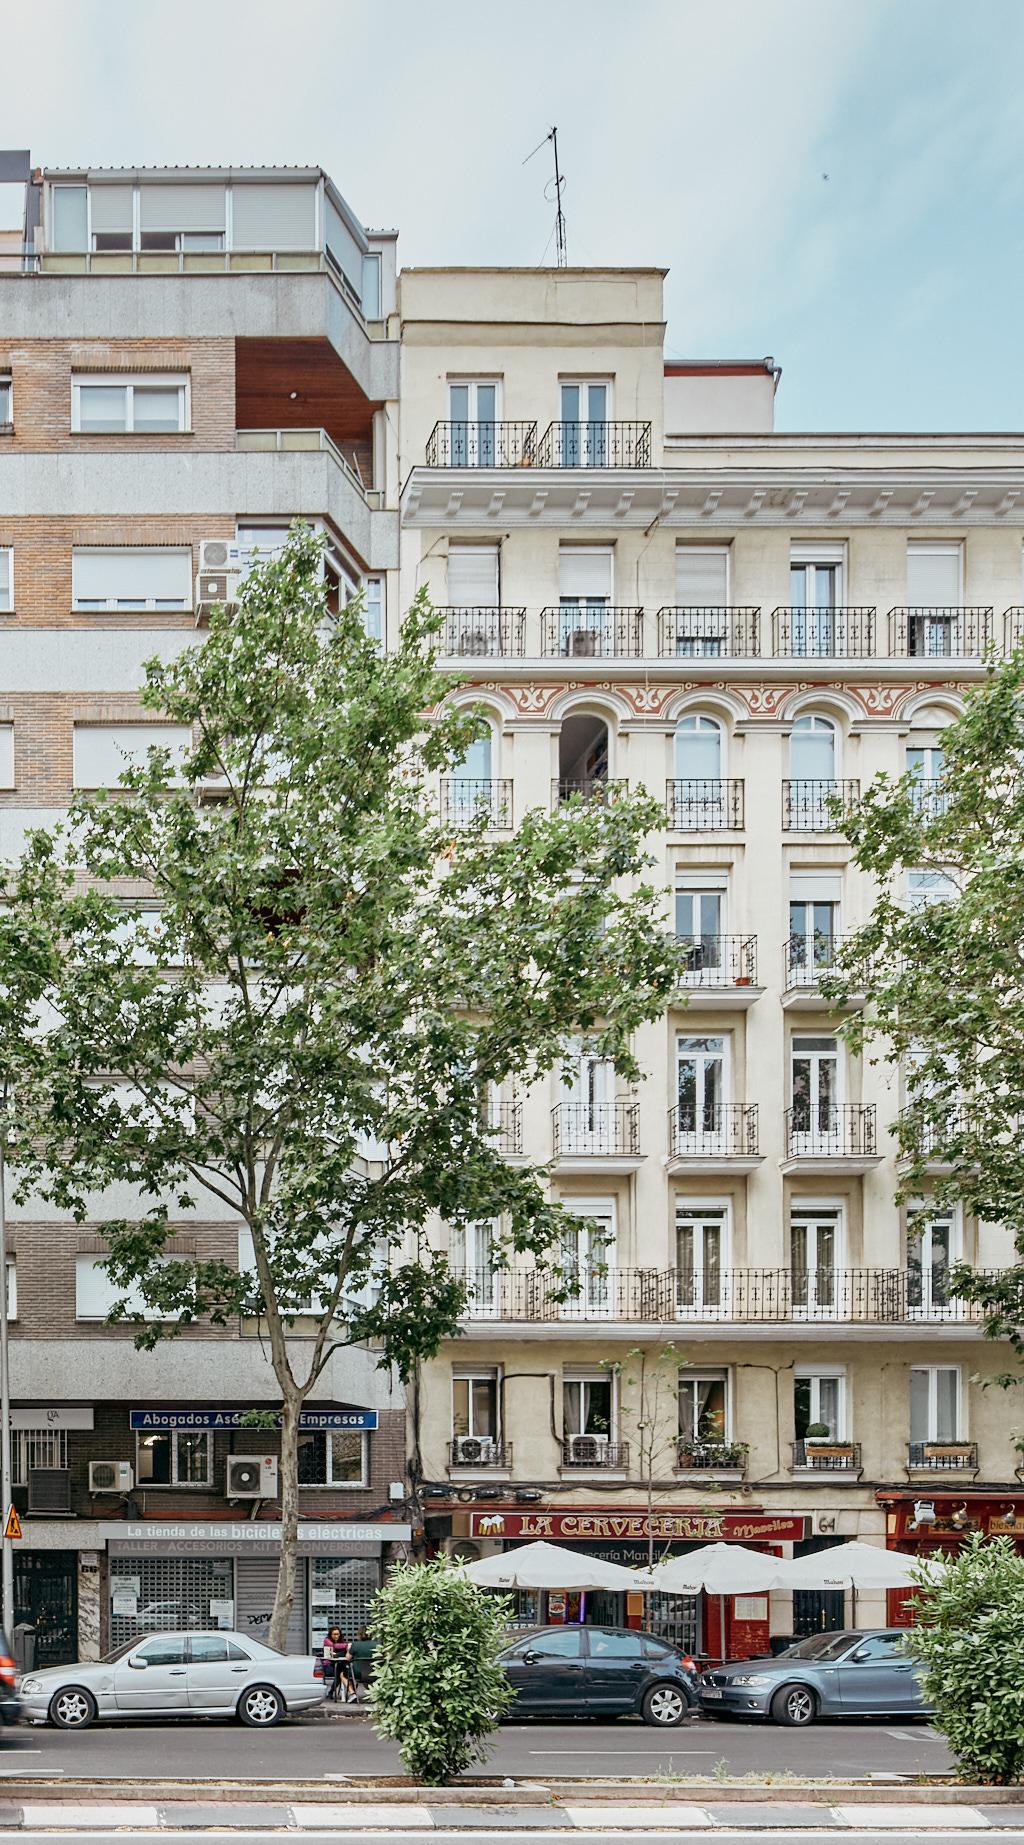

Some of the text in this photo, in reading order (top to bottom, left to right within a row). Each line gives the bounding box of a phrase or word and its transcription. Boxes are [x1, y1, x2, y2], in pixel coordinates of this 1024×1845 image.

[142, 1413, 210, 1427] Abogados
[299, 1413, 365, 1427] Empresas
[127, 1524, 382, 1539] La tienda de las bicicles eléctricas
[518, 1516, 554, 1536] LA
[818, 1517, 836, 1533] 64
[116, 1541, 158, 1551] TALLER
[167, 1541, 243, 1551] ACCESORIOS
[252, 1541, 270, 1551] KIT
[81, 1565, 98, 1574] 66
